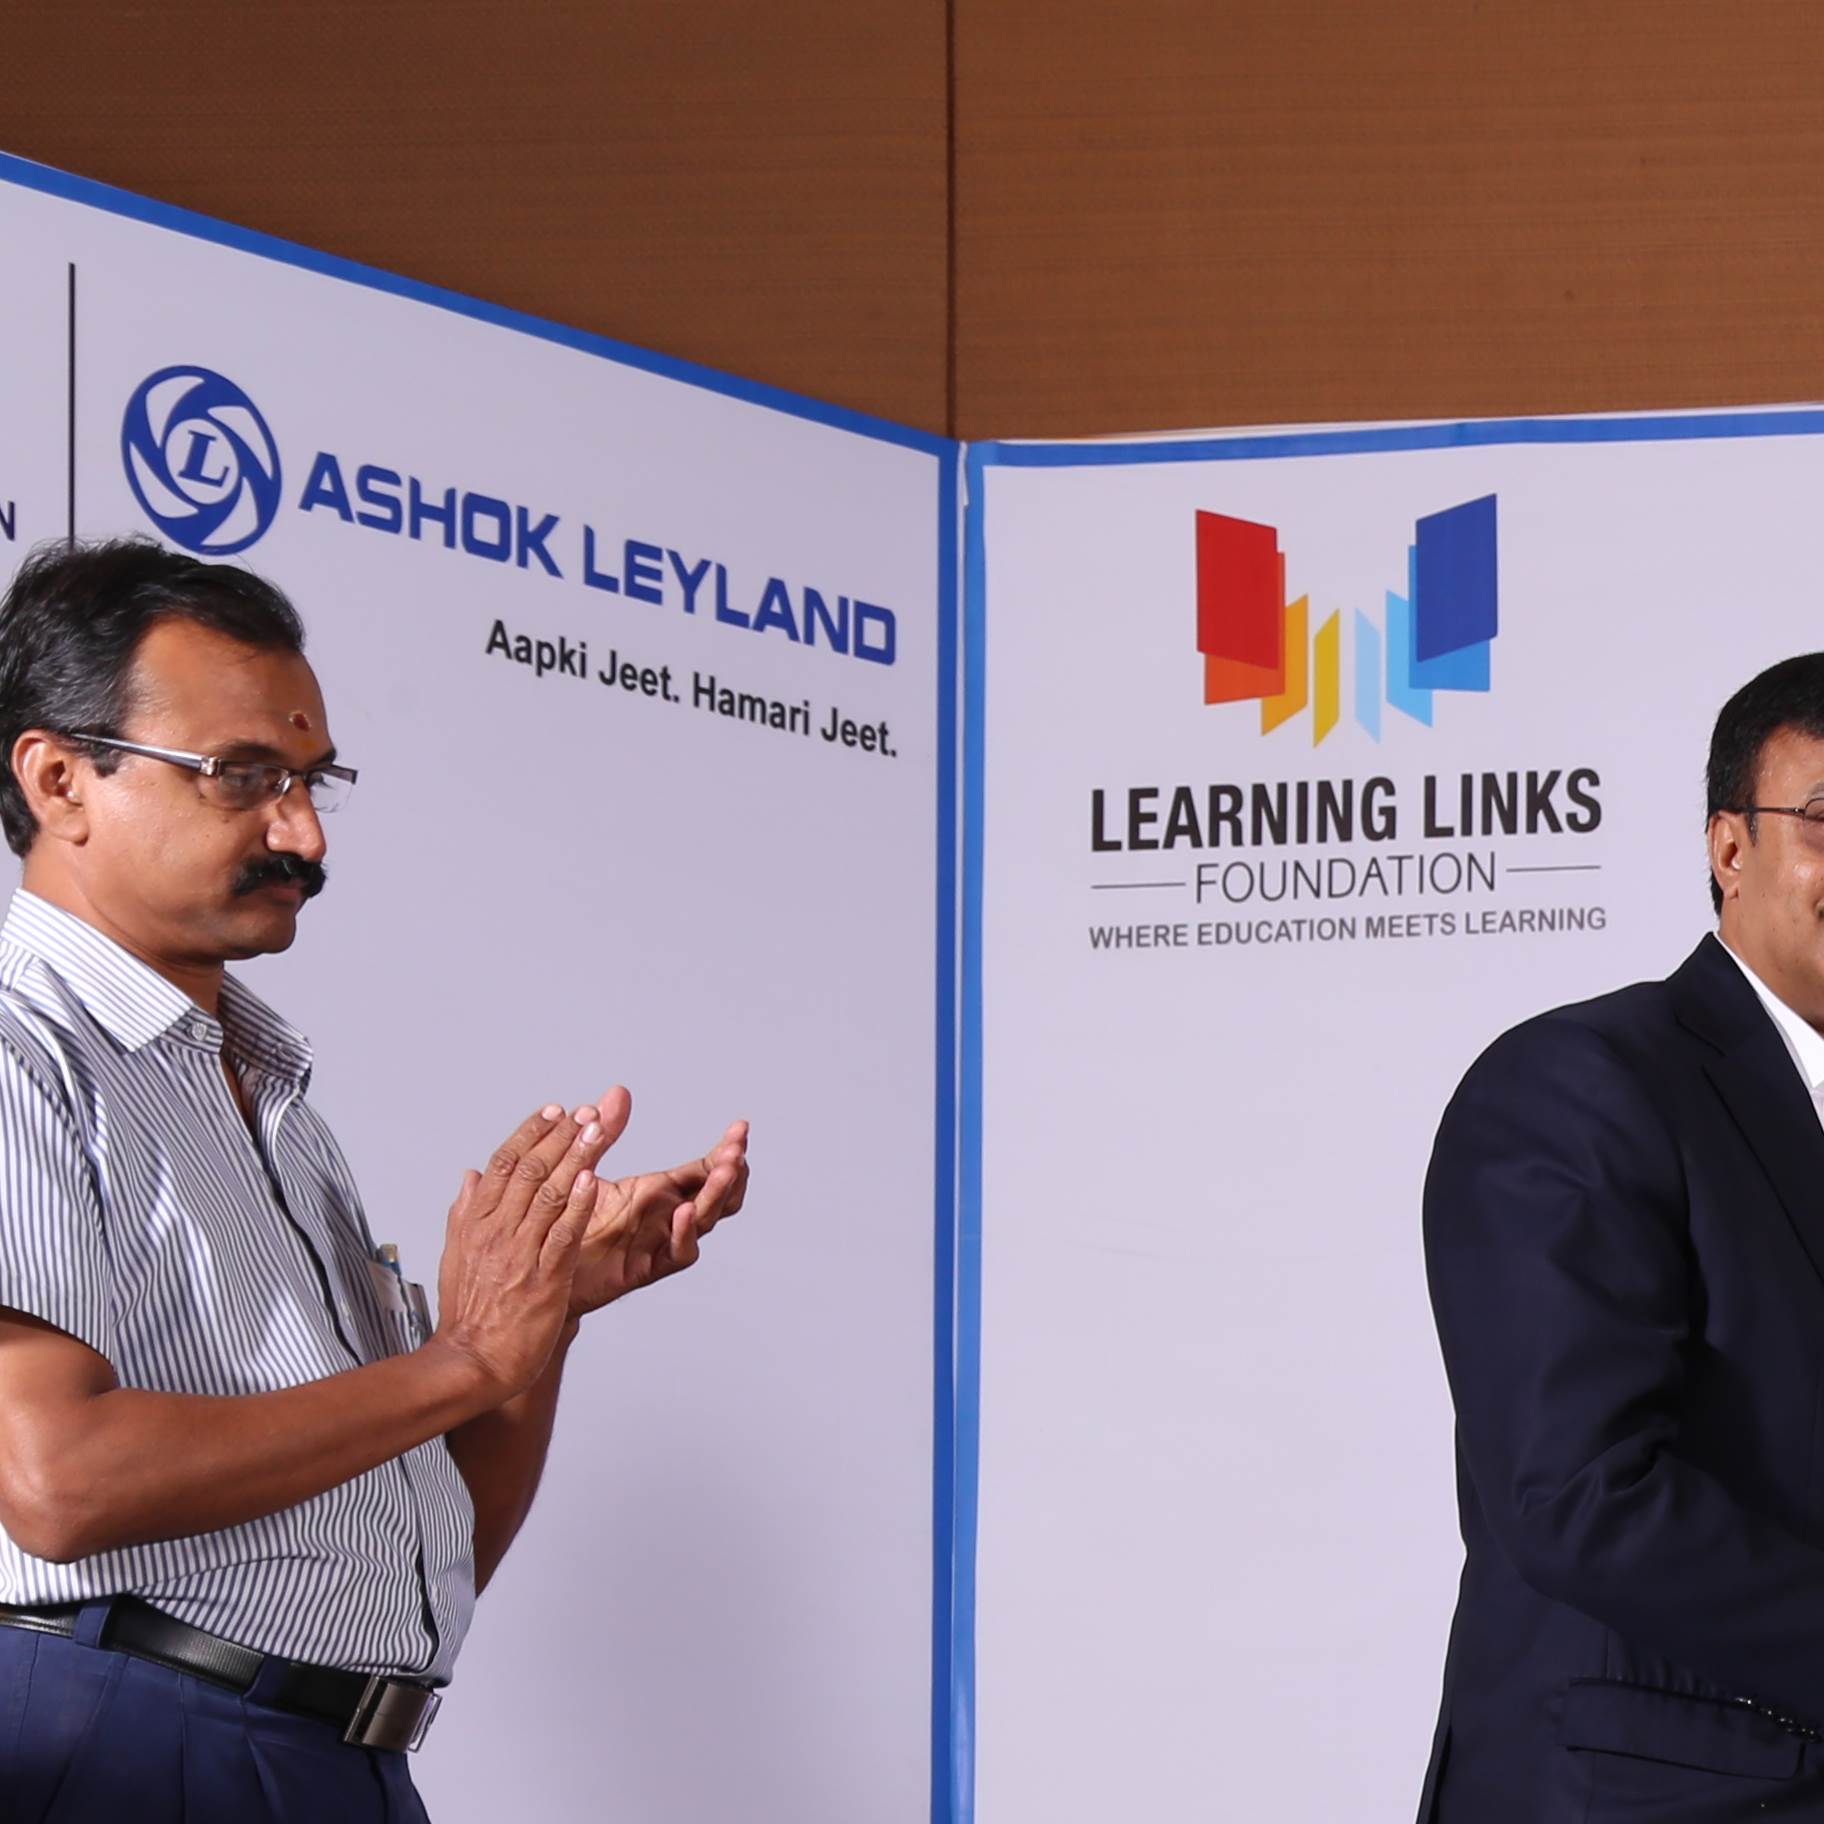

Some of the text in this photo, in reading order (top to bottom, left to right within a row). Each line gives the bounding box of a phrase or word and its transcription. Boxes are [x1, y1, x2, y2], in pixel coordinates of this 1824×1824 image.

[299, 452, 897, 667] ASHOK LEYLAND
[486, 619, 898, 758] Aapki Jeet. Hamari Jeet.
[1091, 768, 1602, 852] LEARNING LINKS
[1196, 851, 1496, 904] FOUNDATION
[1089, 907, 1607, 950] WHERE EDUCATION MEETS LEARNING
